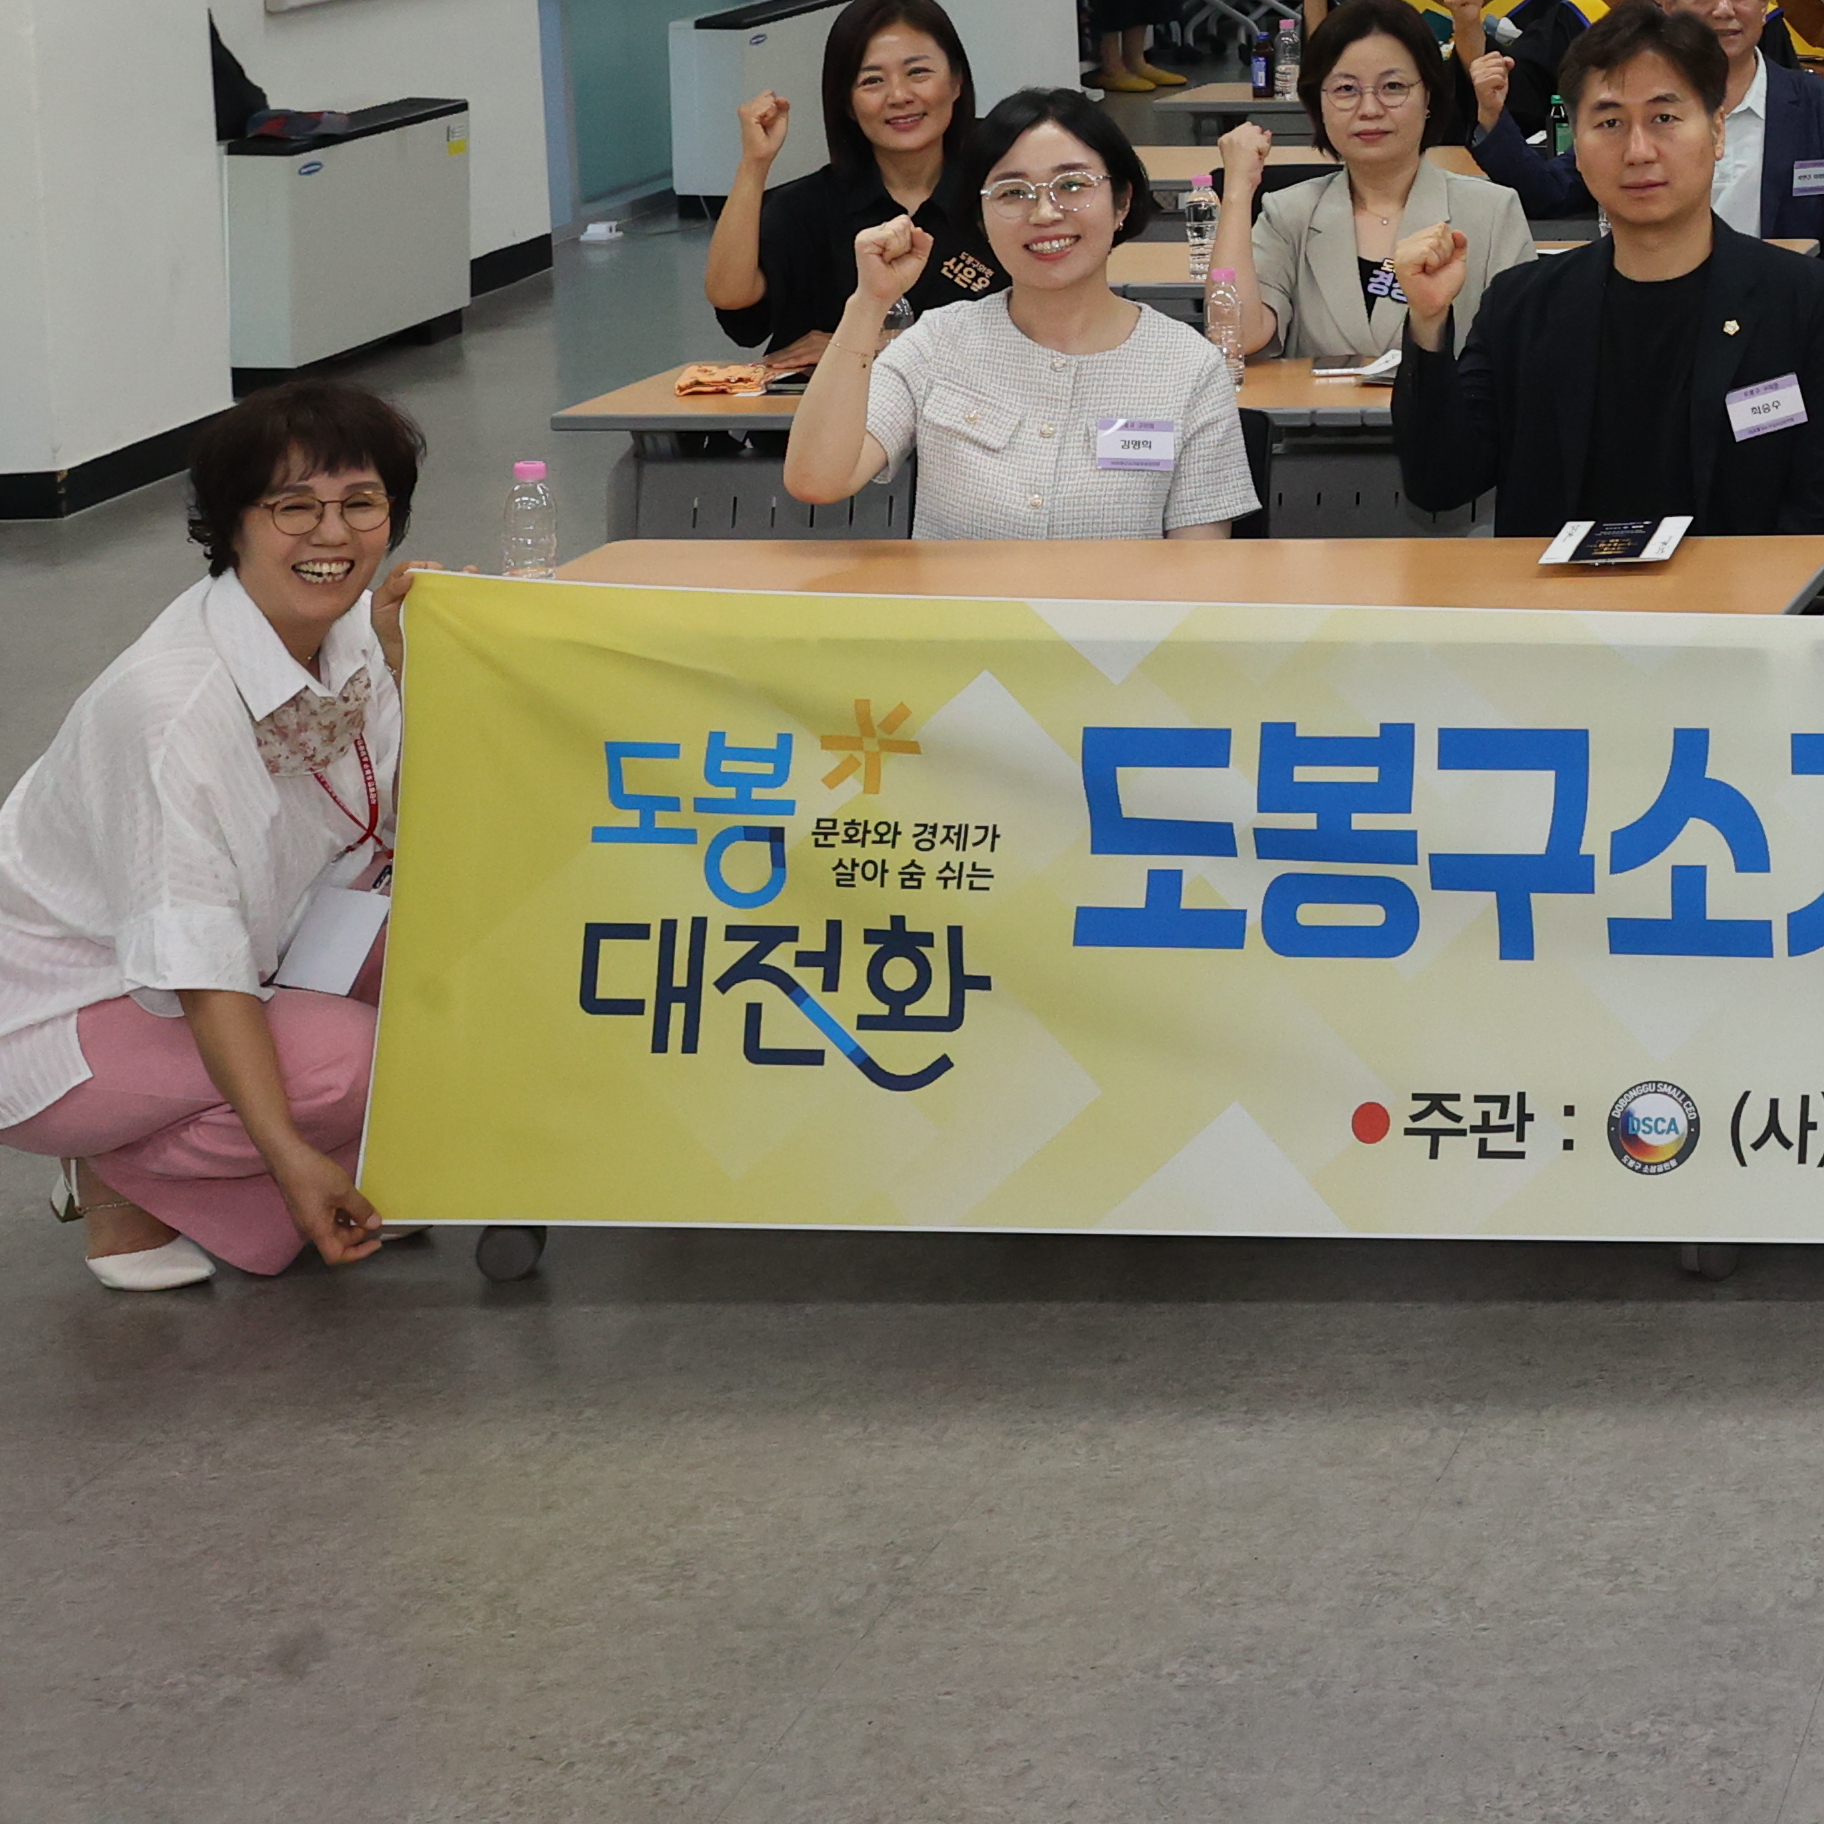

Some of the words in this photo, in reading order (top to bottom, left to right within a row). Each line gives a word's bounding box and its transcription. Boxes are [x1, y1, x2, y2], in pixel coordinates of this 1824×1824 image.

[592, 731, 797, 909] 도봉
[811, 818, 902, 850] 문화와
[912, 822, 1001, 854] 경제가
[831, 858, 890, 889] 살아
[898, 858, 927, 890] 숨
[936, 860, 995, 892] 쉬는
[579, 914, 992, 1092] 대전환
[1611, 1082, 1656, 1119] DOBONGGU
[1656, 1082, 1686, 1104] SMALL
[1683, 1100, 1698, 1120] CEO
[1404, 1092, 1534, 1159] 주관
[1628, 1116, 1679, 1135] DSCA
